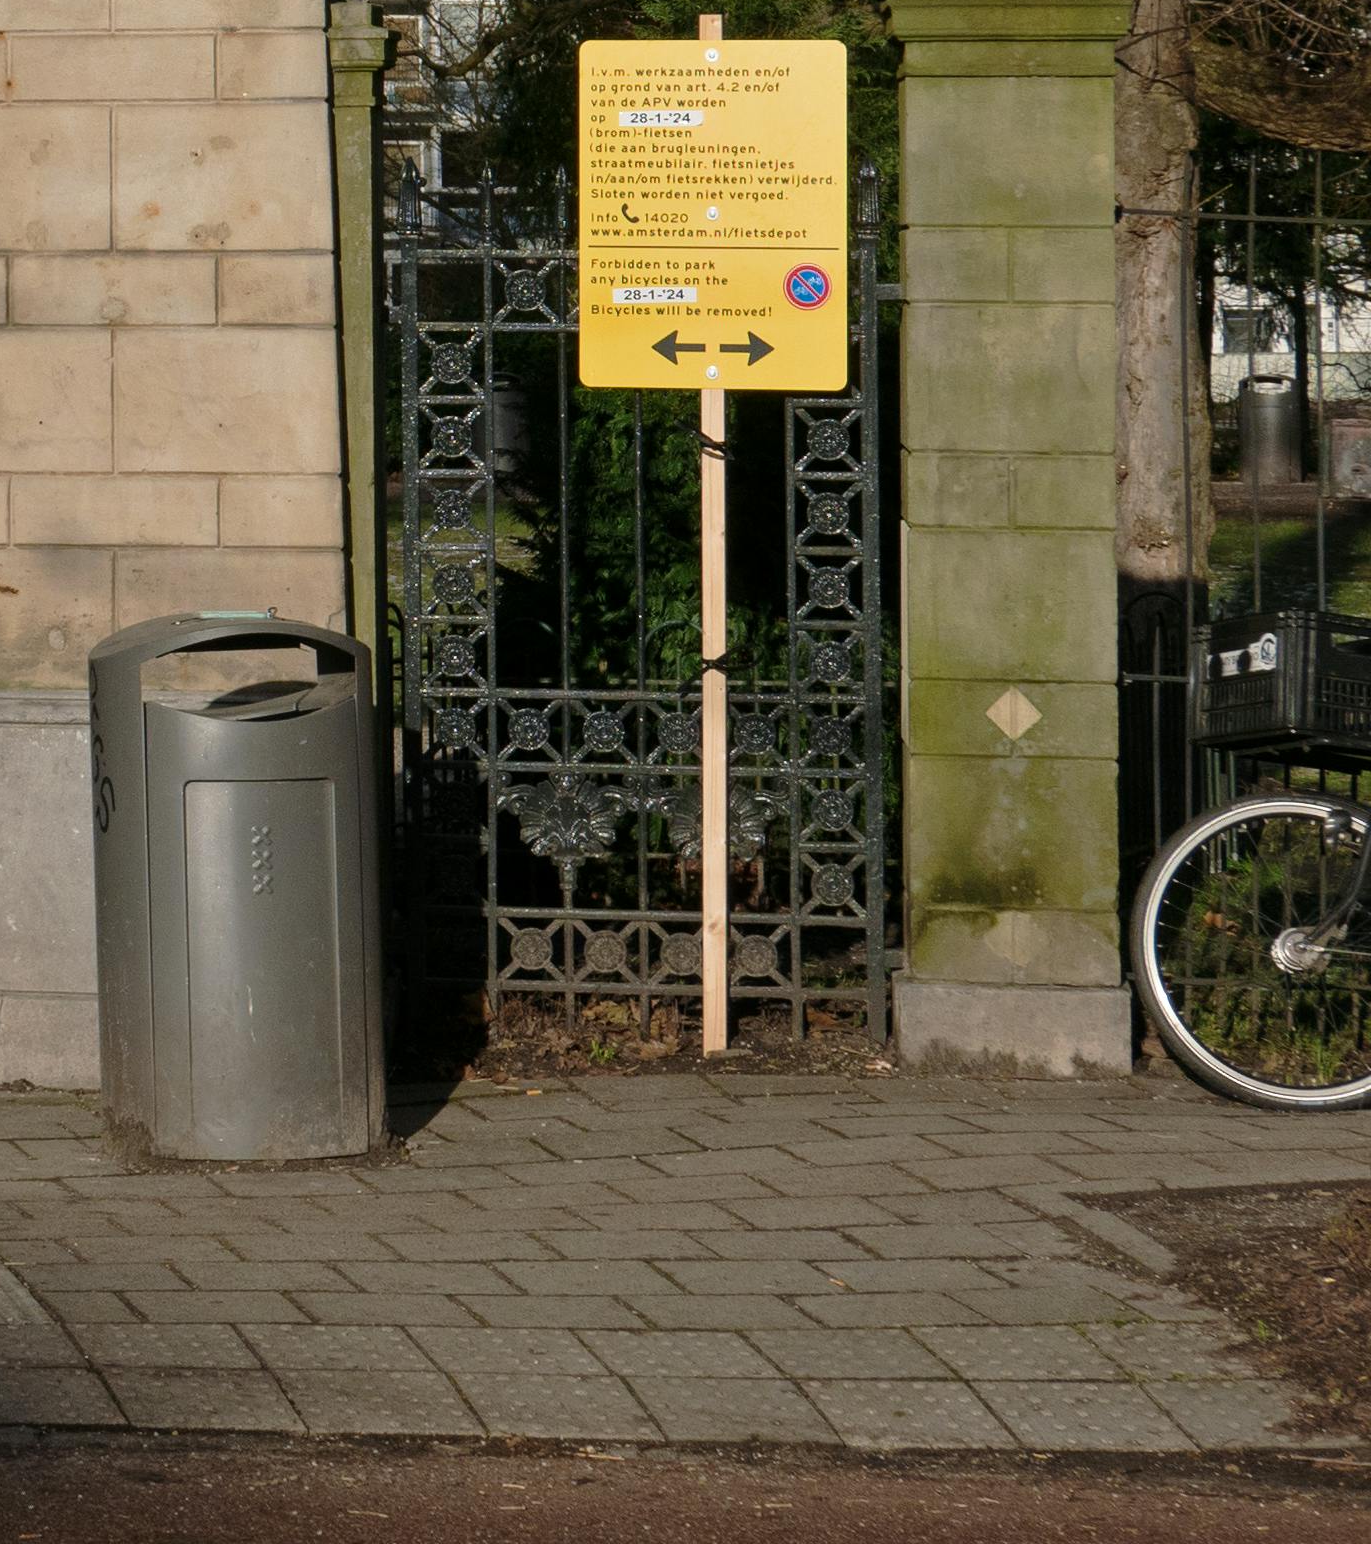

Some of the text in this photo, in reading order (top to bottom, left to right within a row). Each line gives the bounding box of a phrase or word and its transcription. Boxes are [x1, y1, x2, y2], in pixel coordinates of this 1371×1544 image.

[635, 66, 750, 77] werkzaamheden
[754, 66, 790, 78] en/of
[590, 81, 780, 95] op grond van art. 4.2 en/of
[590, 96, 727, 108] van de APV worden
[590, 114, 606, 125] op
[589, 143, 616, 153] (die
[620, 144, 646, 153] aan
[712, 158, 795, 173] fietsnietjes
[590, 172, 837, 188] in/aan/om fietsrekken) verwijderd.
[590, 188, 788, 204] Sloten worden niet vergoed.
[591, 212, 689, 224] Info 14020
[590, 227, 807, 240] www.amsterdam.nl/fietsdepot
[591, 258, 716, 272] Forbidden to park
[590, 274, 729, 287] any bicycles on the
[591, 304, 772, 318] Bicycles will be removed!
